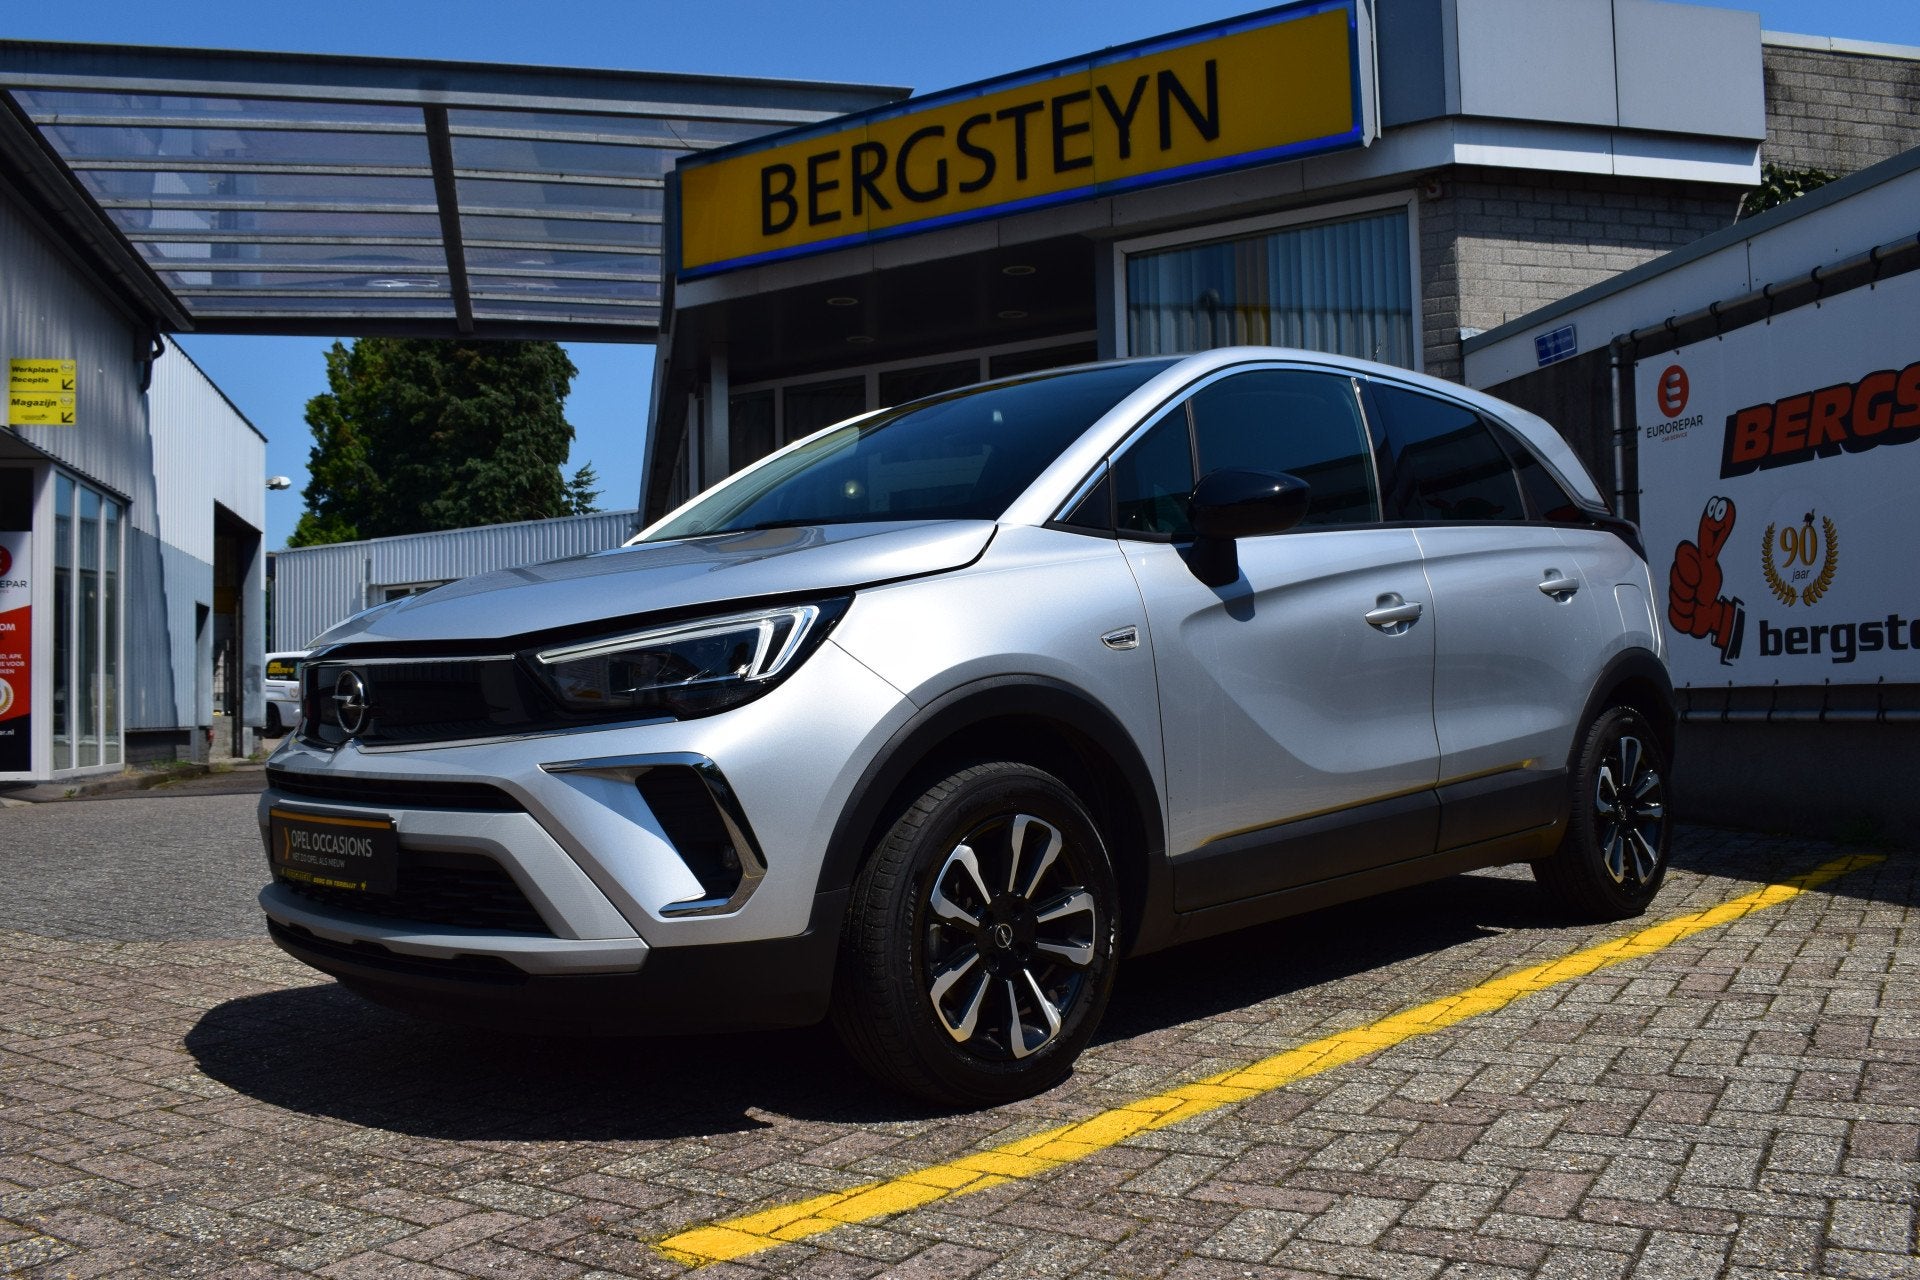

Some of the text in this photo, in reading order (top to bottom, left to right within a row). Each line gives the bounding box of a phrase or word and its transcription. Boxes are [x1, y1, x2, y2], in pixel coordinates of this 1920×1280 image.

[760, 58, 1221, 237] BERGSTEYN
[11, 366, 59, 374] Werkplaats
[11, 376, 50, 384] Receptie
[11, 398, 57, 408] Magazijn
[1646, 414, 1704, 439] EUROREPAR
[1779, 526, 1818, 568] 90
[1791, 567, 1811, 583] jaar
[291, 829, 373, 858] OPEL OCCASIONS
